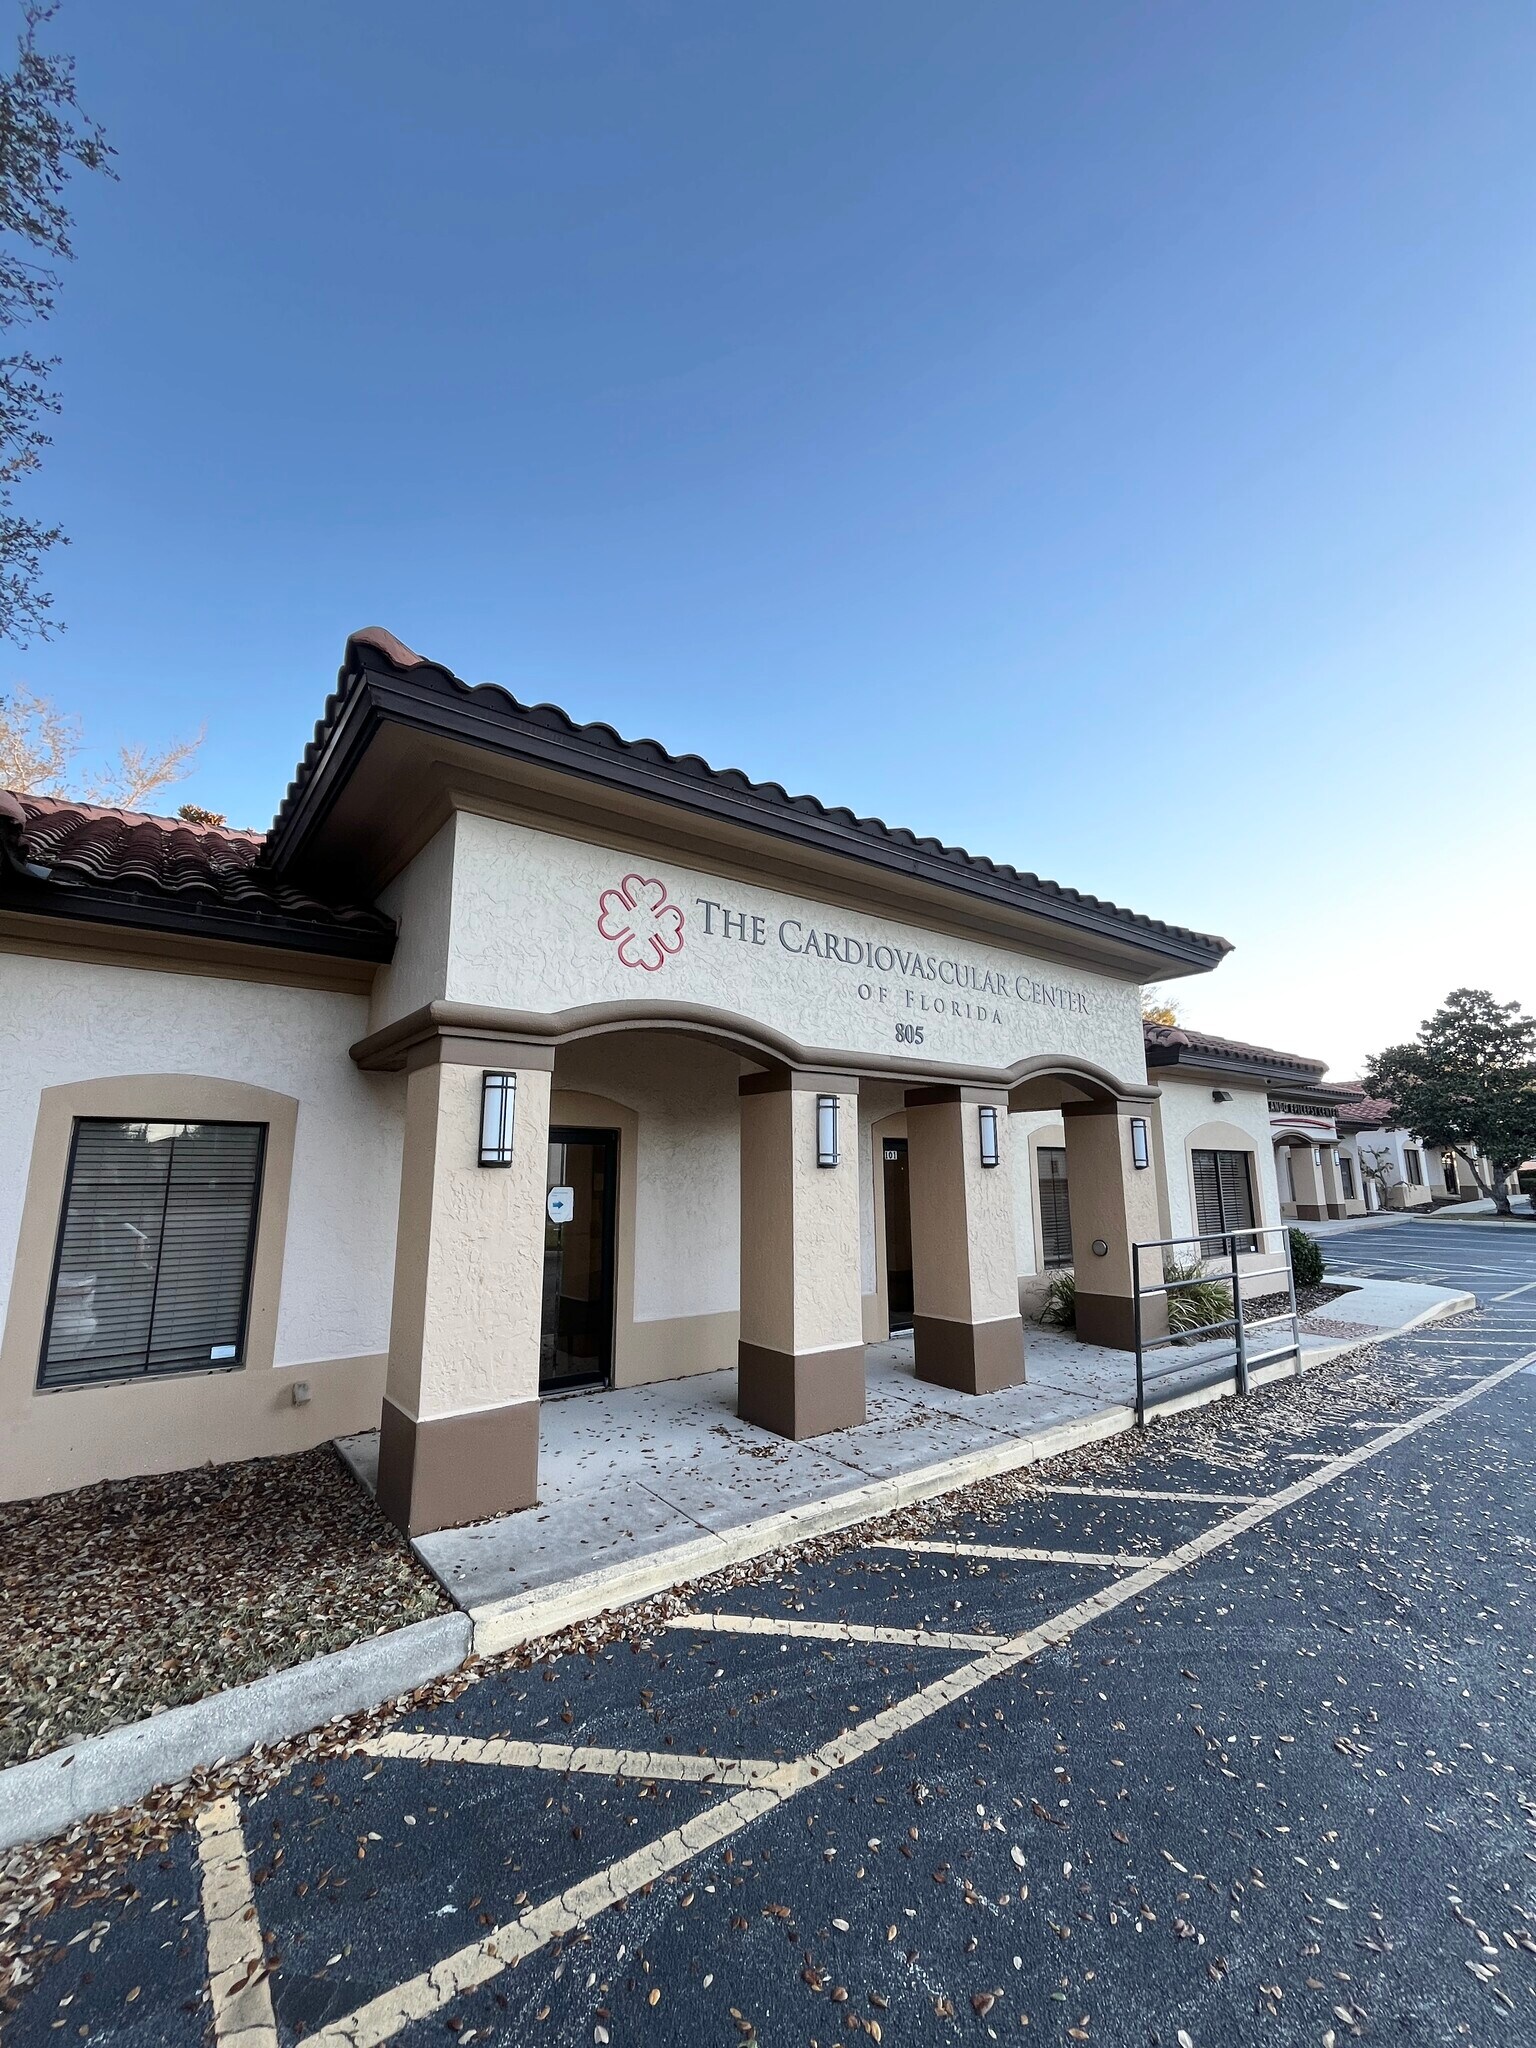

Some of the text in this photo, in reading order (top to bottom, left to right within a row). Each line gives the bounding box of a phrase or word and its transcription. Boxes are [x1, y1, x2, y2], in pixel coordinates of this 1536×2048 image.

[696, 898, 1090, 1015] THE CARDIOVASCULAR CENTER
[858, 984, 1002, 1024] OF FLORIDA
[895, 1022, 924, 1045] 805
[885, 1151, 897, 1159] 101
